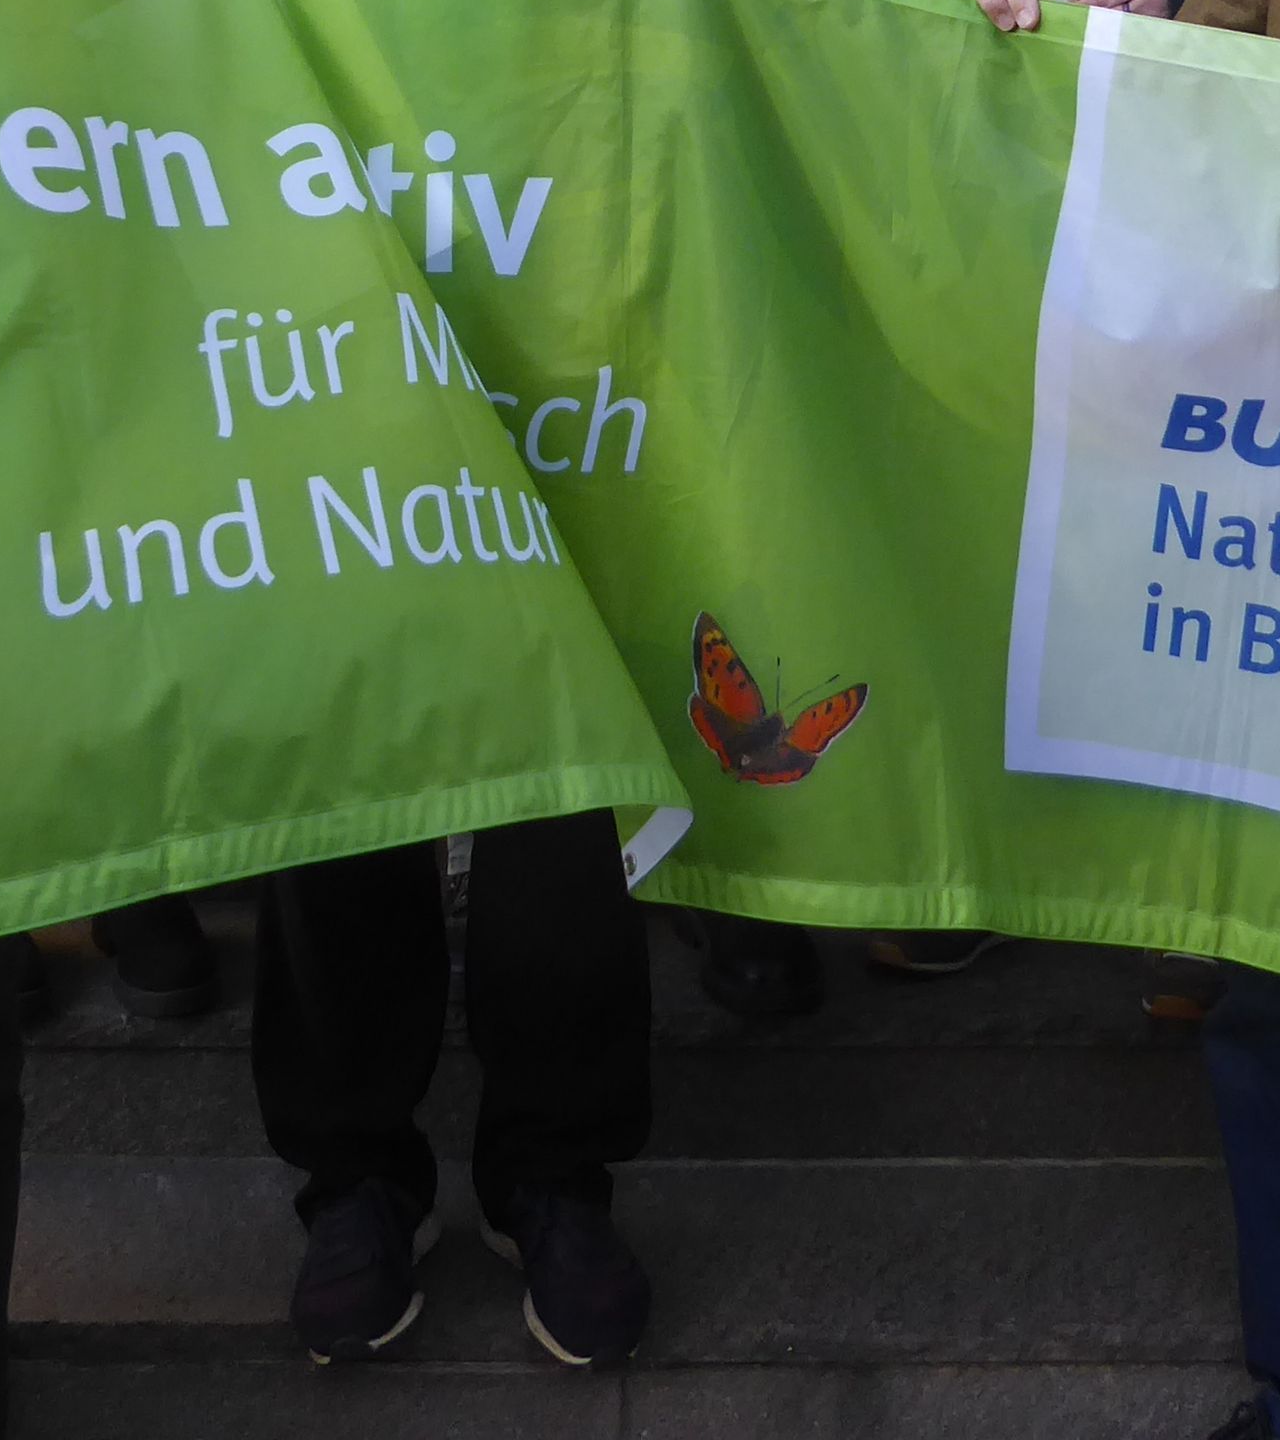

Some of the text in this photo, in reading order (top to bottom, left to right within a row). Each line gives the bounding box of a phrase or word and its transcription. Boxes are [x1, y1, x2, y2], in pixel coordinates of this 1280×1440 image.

[265, 122, 554, 277] ativ
[198, 308, 354, 438] für
[39, 465, 561, 617] und Natur
[1141, 581, 1212, 662] in
